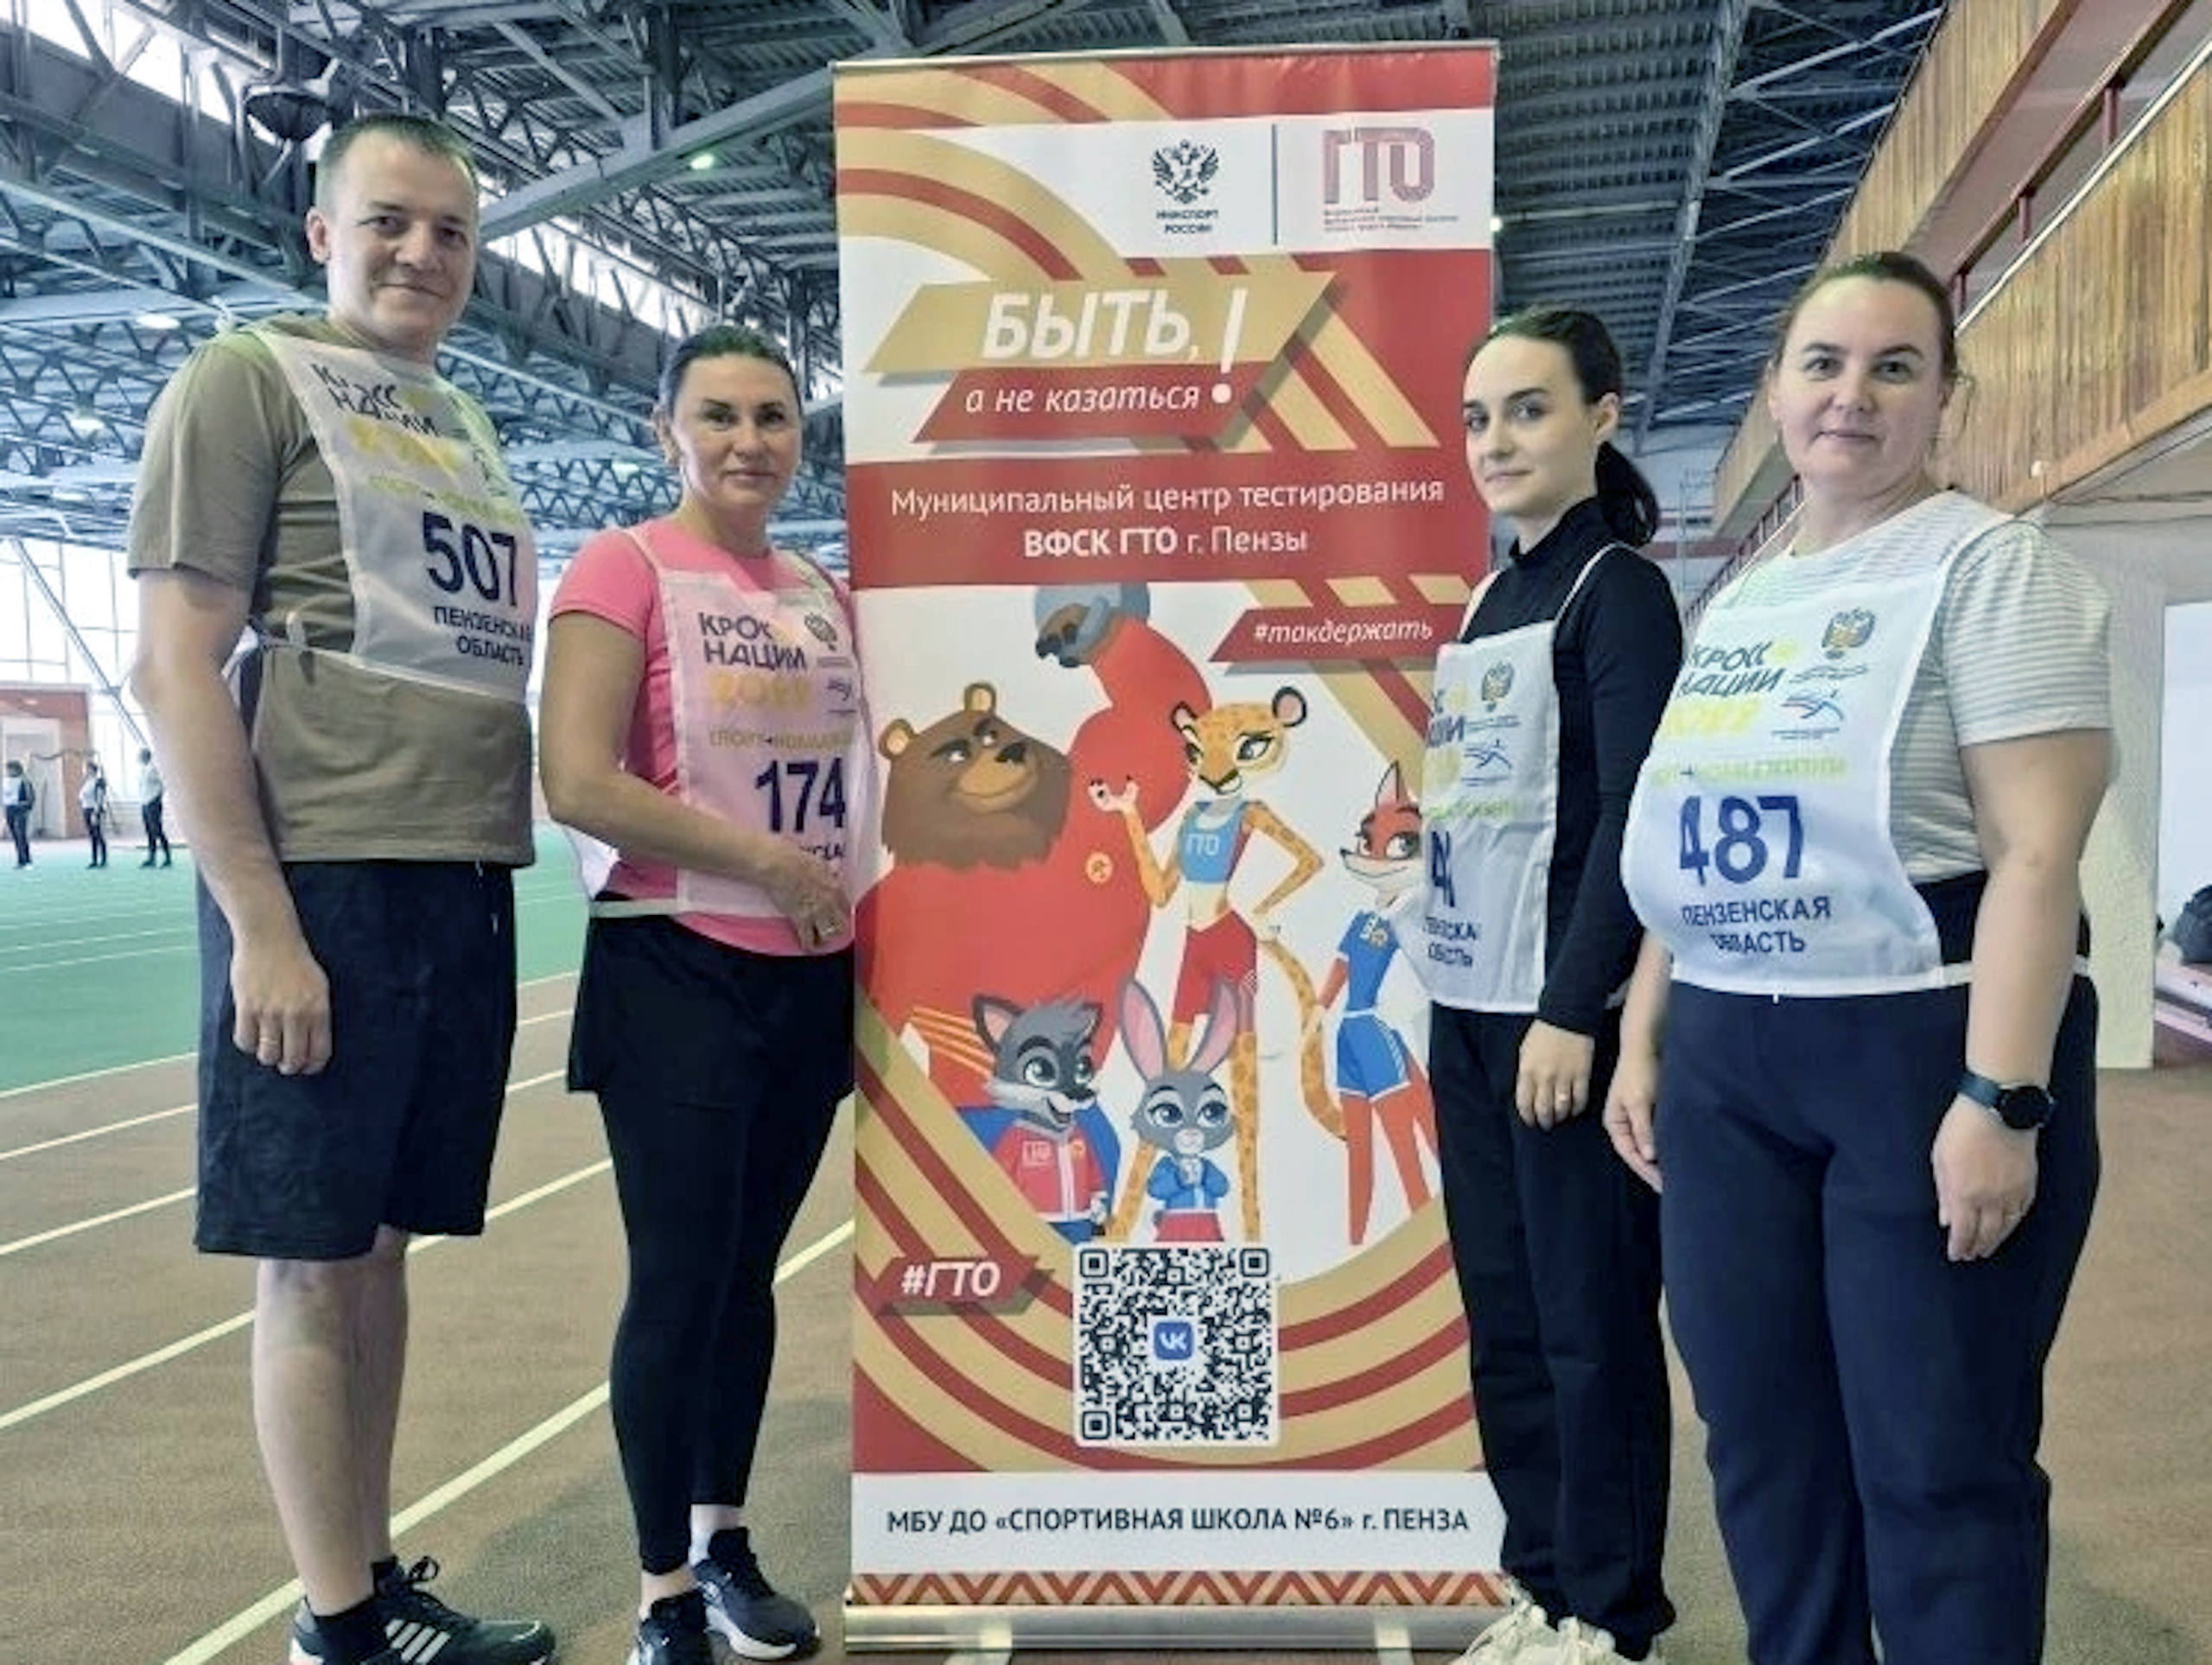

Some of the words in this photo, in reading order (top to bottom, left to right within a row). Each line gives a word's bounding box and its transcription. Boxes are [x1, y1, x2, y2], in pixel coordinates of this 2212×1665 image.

[1323, 126, 1434, 204] ГТО
[982, 289, 1199, 361] БЫТЬ,
[965, 389, 984, 413] а
[995, 388, 1034, 412] не
[1046, 385, 1200, 412] казаться
[891, 484, 1135, 522] Муниципальный
[1143, 486, 1231, 515] центр
[1238, 480, 1445, 512] тестирования
[423, 510, 517, 606] 507
[1023, 529, 1110, 558] ВФСК
[1120, 526, 1178, 555] ГТО
[1187, 533, 1204, 555] г.
[1211, 526, 1308, 553] Пензы
[1254, 618, 1433, 645] #такдержать
[755, 758, 846, 834] 174
[1679, 795, 1804, 885] 487
[1682, 895, 1832, 926] ПЕНЗЕНСКАЯ
[900, 1261, 1002, 1297] #ГТО
[887, 1511, 943, 1532] МБУ
[950, 1510, 988, 1534] ДО
[996, 1509, 1183, 1530] «СПОРТИВНАЯ
[1192, 1509, 1287, 1530] ШКОЛА
[1296, 1508, 1354, 1529] №6»
[1363, 1513, 1376, 1529] г.
[1384, 1509, 1470, 1529] ПЕНЗА
